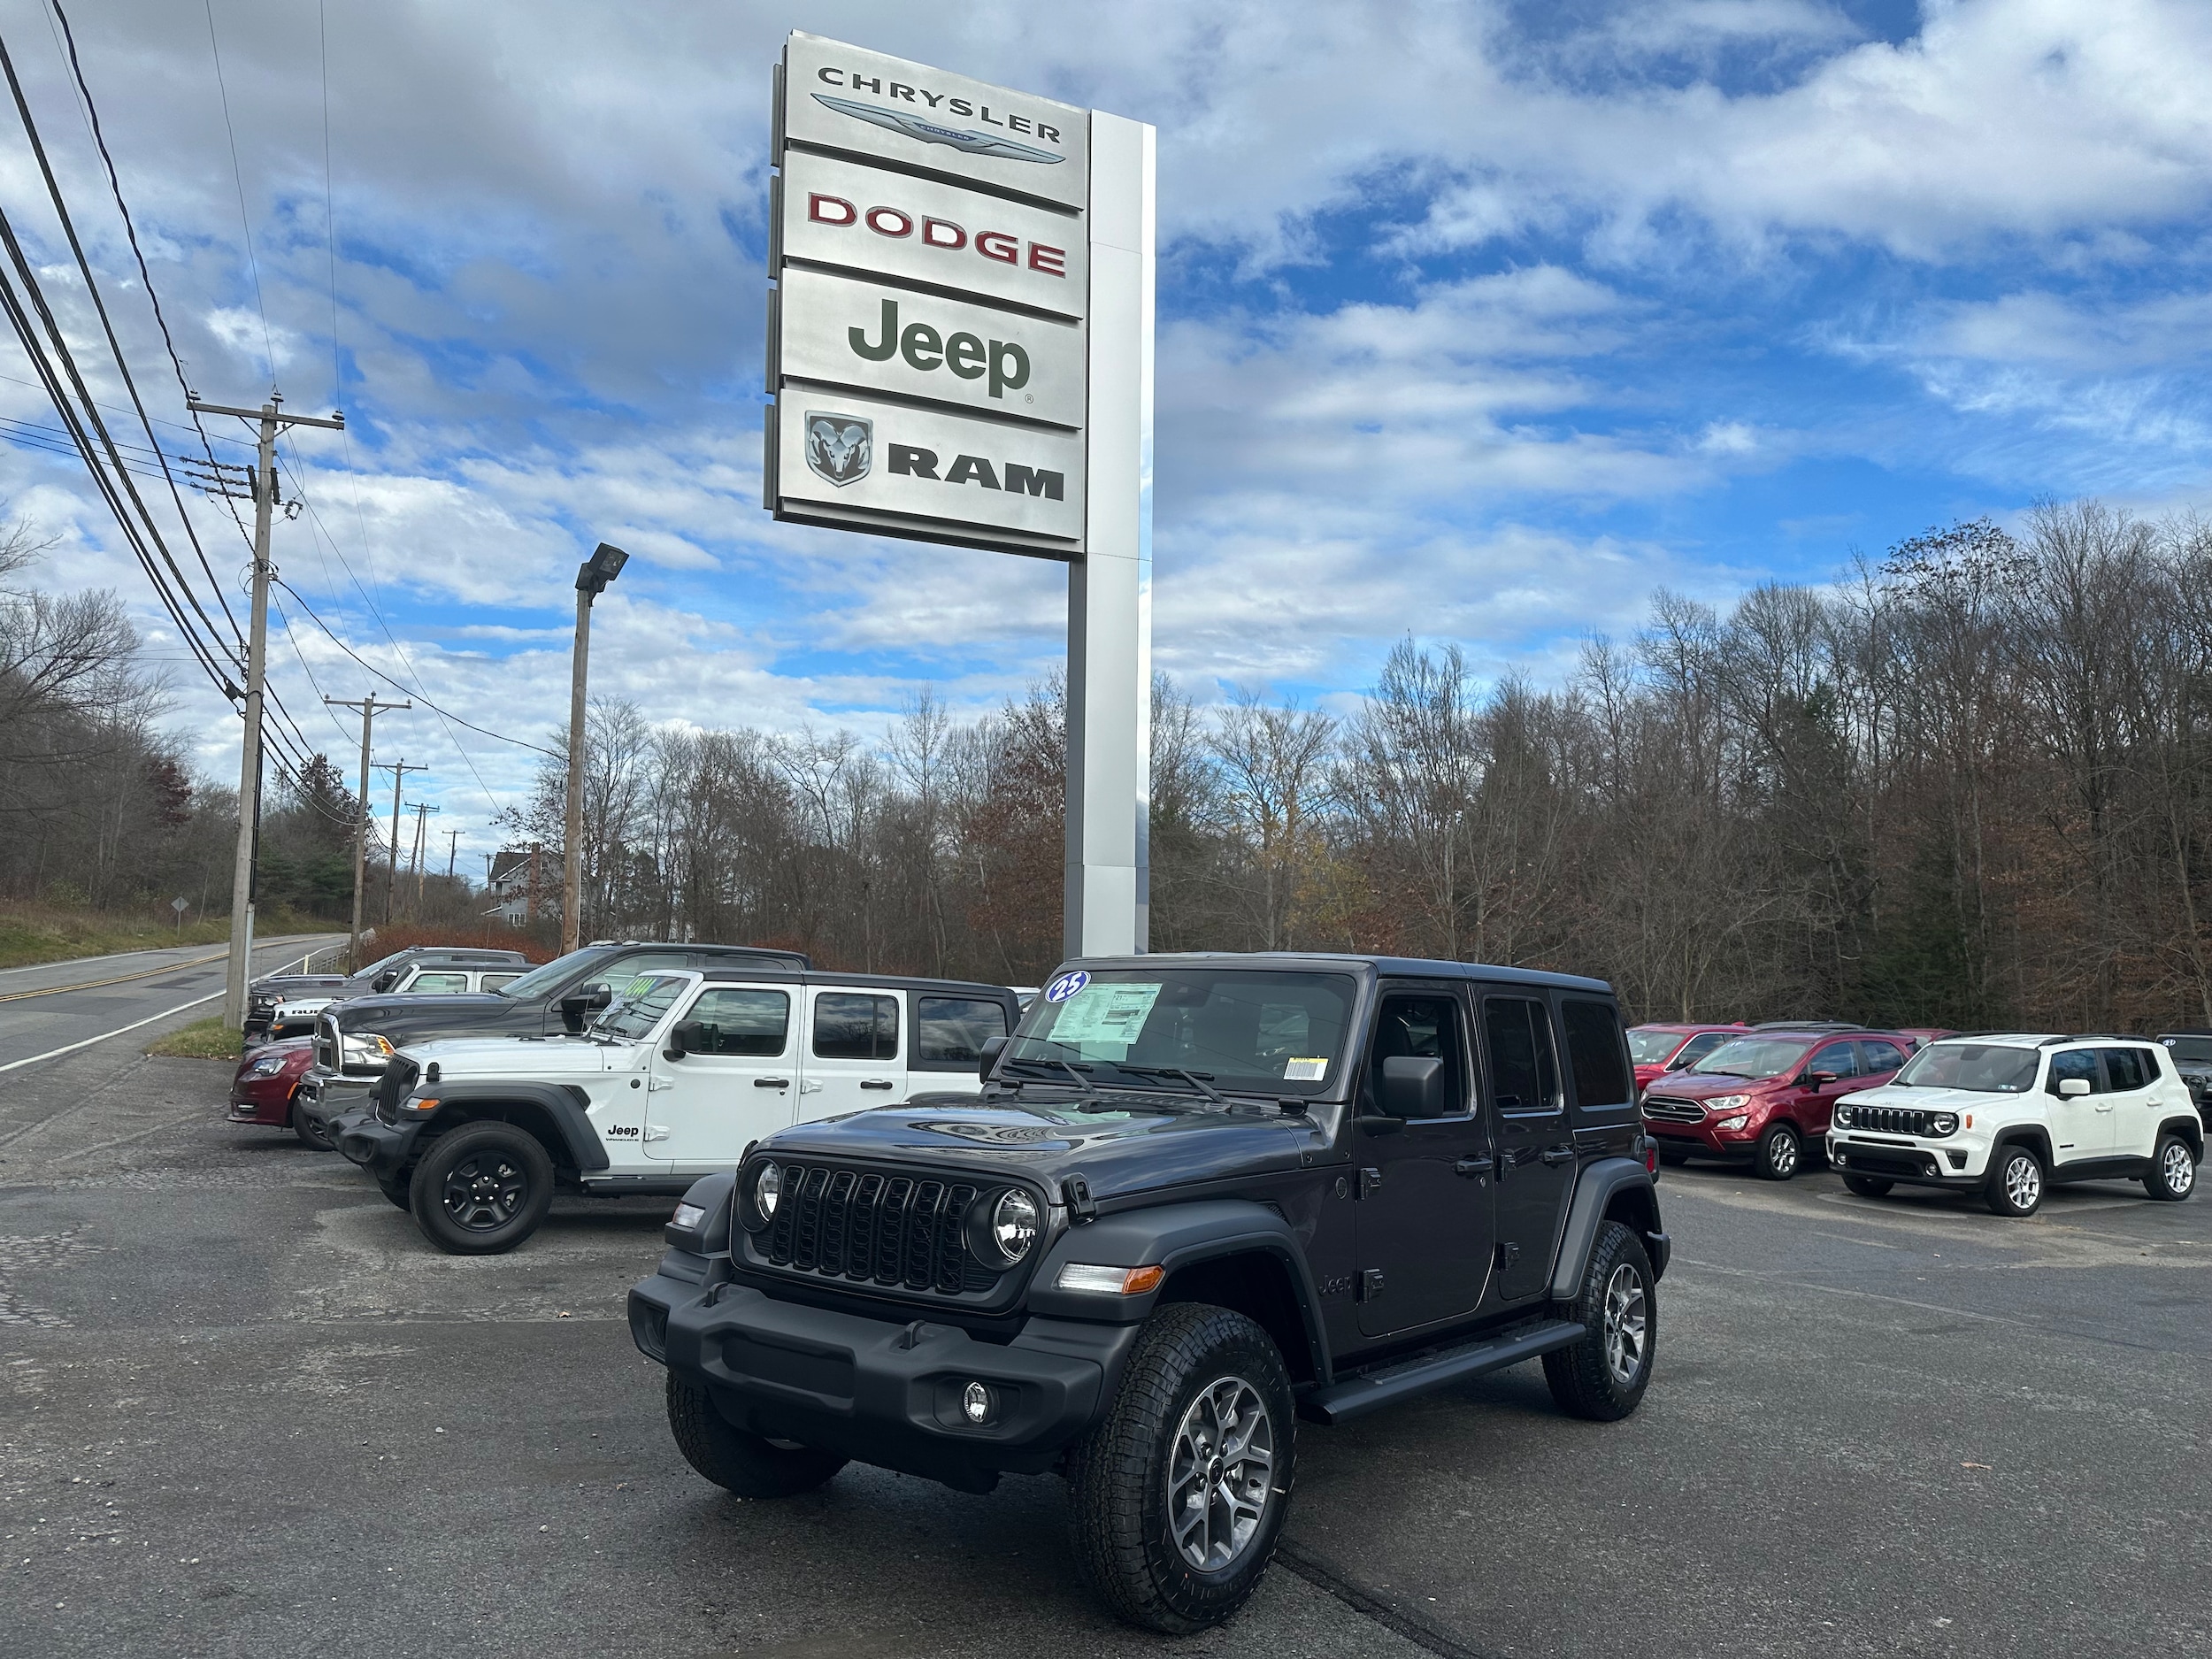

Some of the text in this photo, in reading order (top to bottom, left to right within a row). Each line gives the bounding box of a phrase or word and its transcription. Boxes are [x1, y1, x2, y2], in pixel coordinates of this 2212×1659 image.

[818, 66, 1061, 144] CHRYSLER
[807, 191, 1066, 279] DODGE
[848, 298, 1031, 399] Jeep
[887, 442, 1064, 502] RAM
[1051, 972, 1082, 1002] 25
[608, 1125, 639, 1138] Jeep
[1317, 1274, 1352, 1296] Jeep
